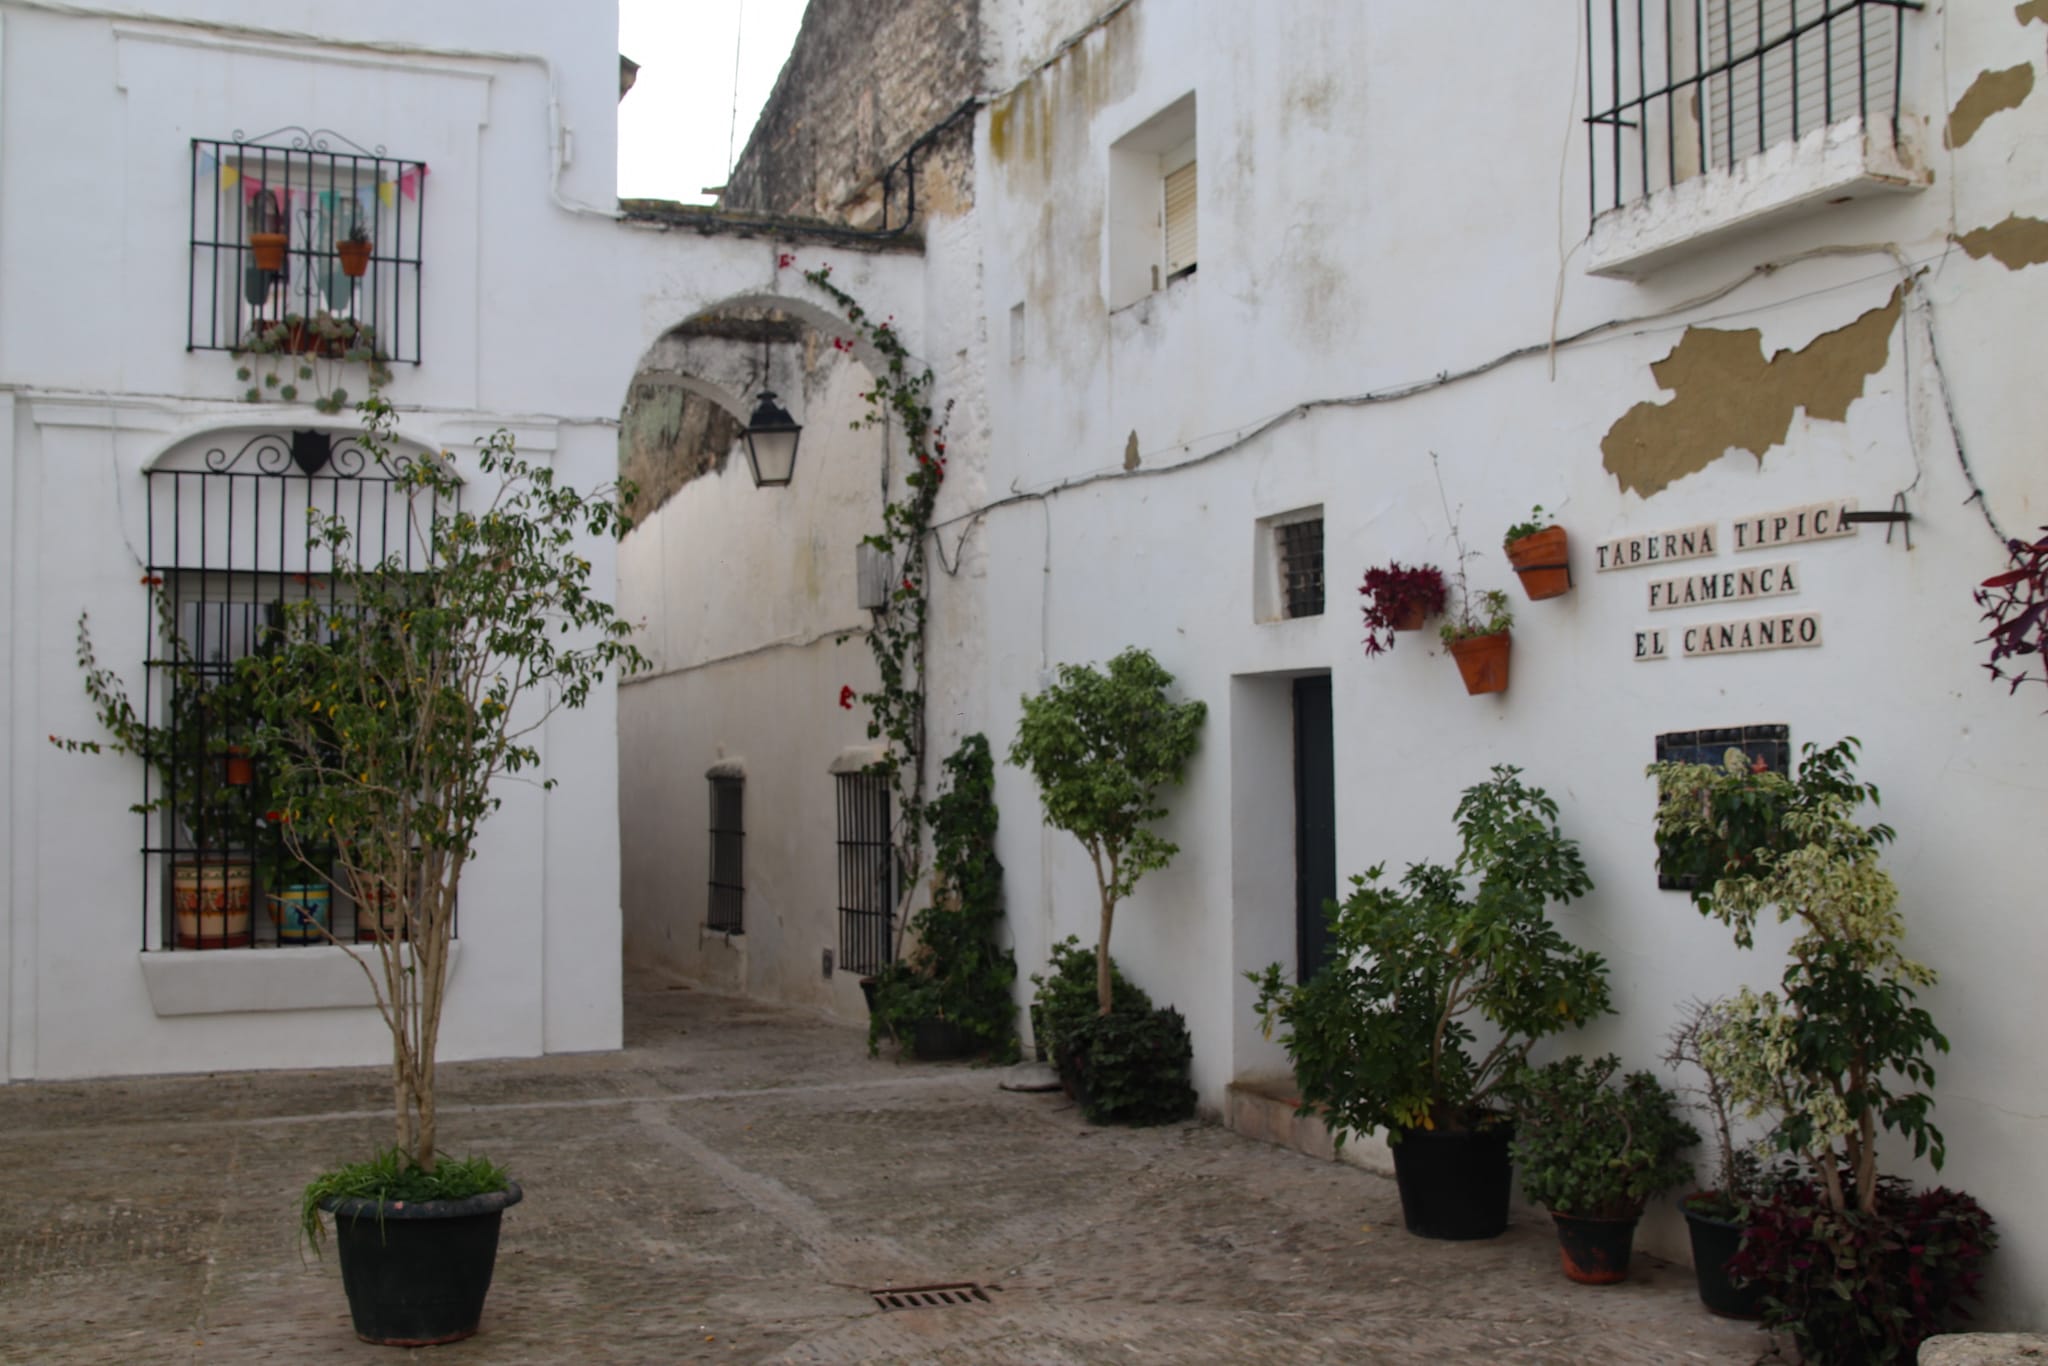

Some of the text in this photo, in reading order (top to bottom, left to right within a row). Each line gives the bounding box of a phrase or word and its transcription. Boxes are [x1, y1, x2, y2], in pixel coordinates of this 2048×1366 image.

[1597, 505, 1852, 568] TABERNA TIPICA
[1650, 565, 1795, 606] FLAMENCA
[1635, 617, 1817, 657] EL CANANEO
